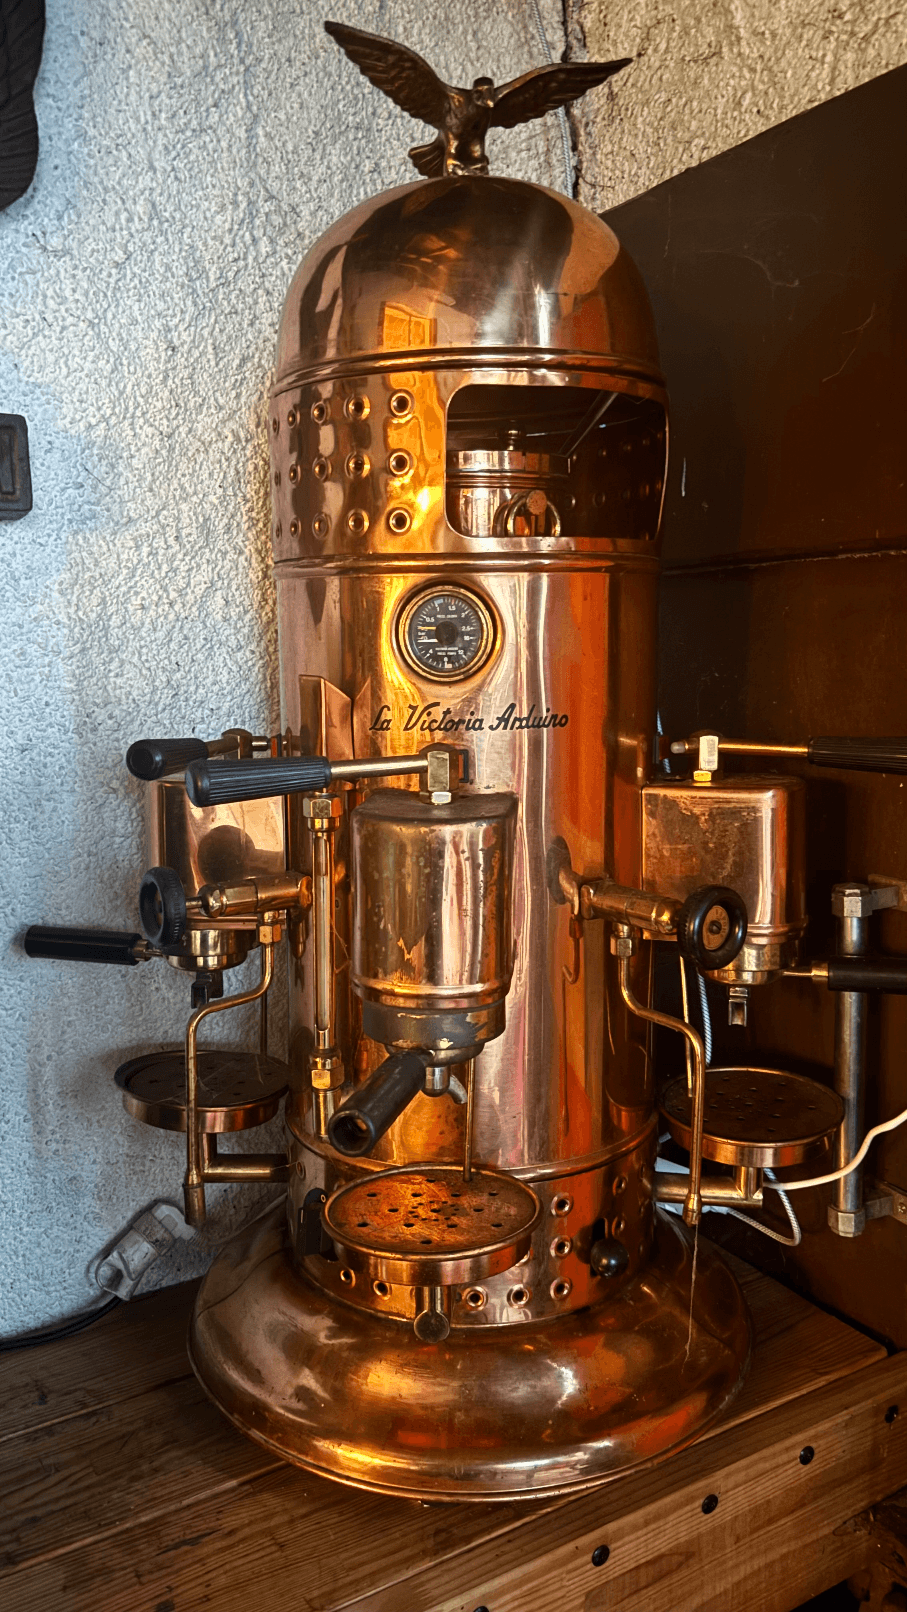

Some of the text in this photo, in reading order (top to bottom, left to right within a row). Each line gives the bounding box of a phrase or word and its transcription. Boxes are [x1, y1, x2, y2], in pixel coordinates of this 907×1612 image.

[369, 702, 569, 732] La Victoria Arduino
